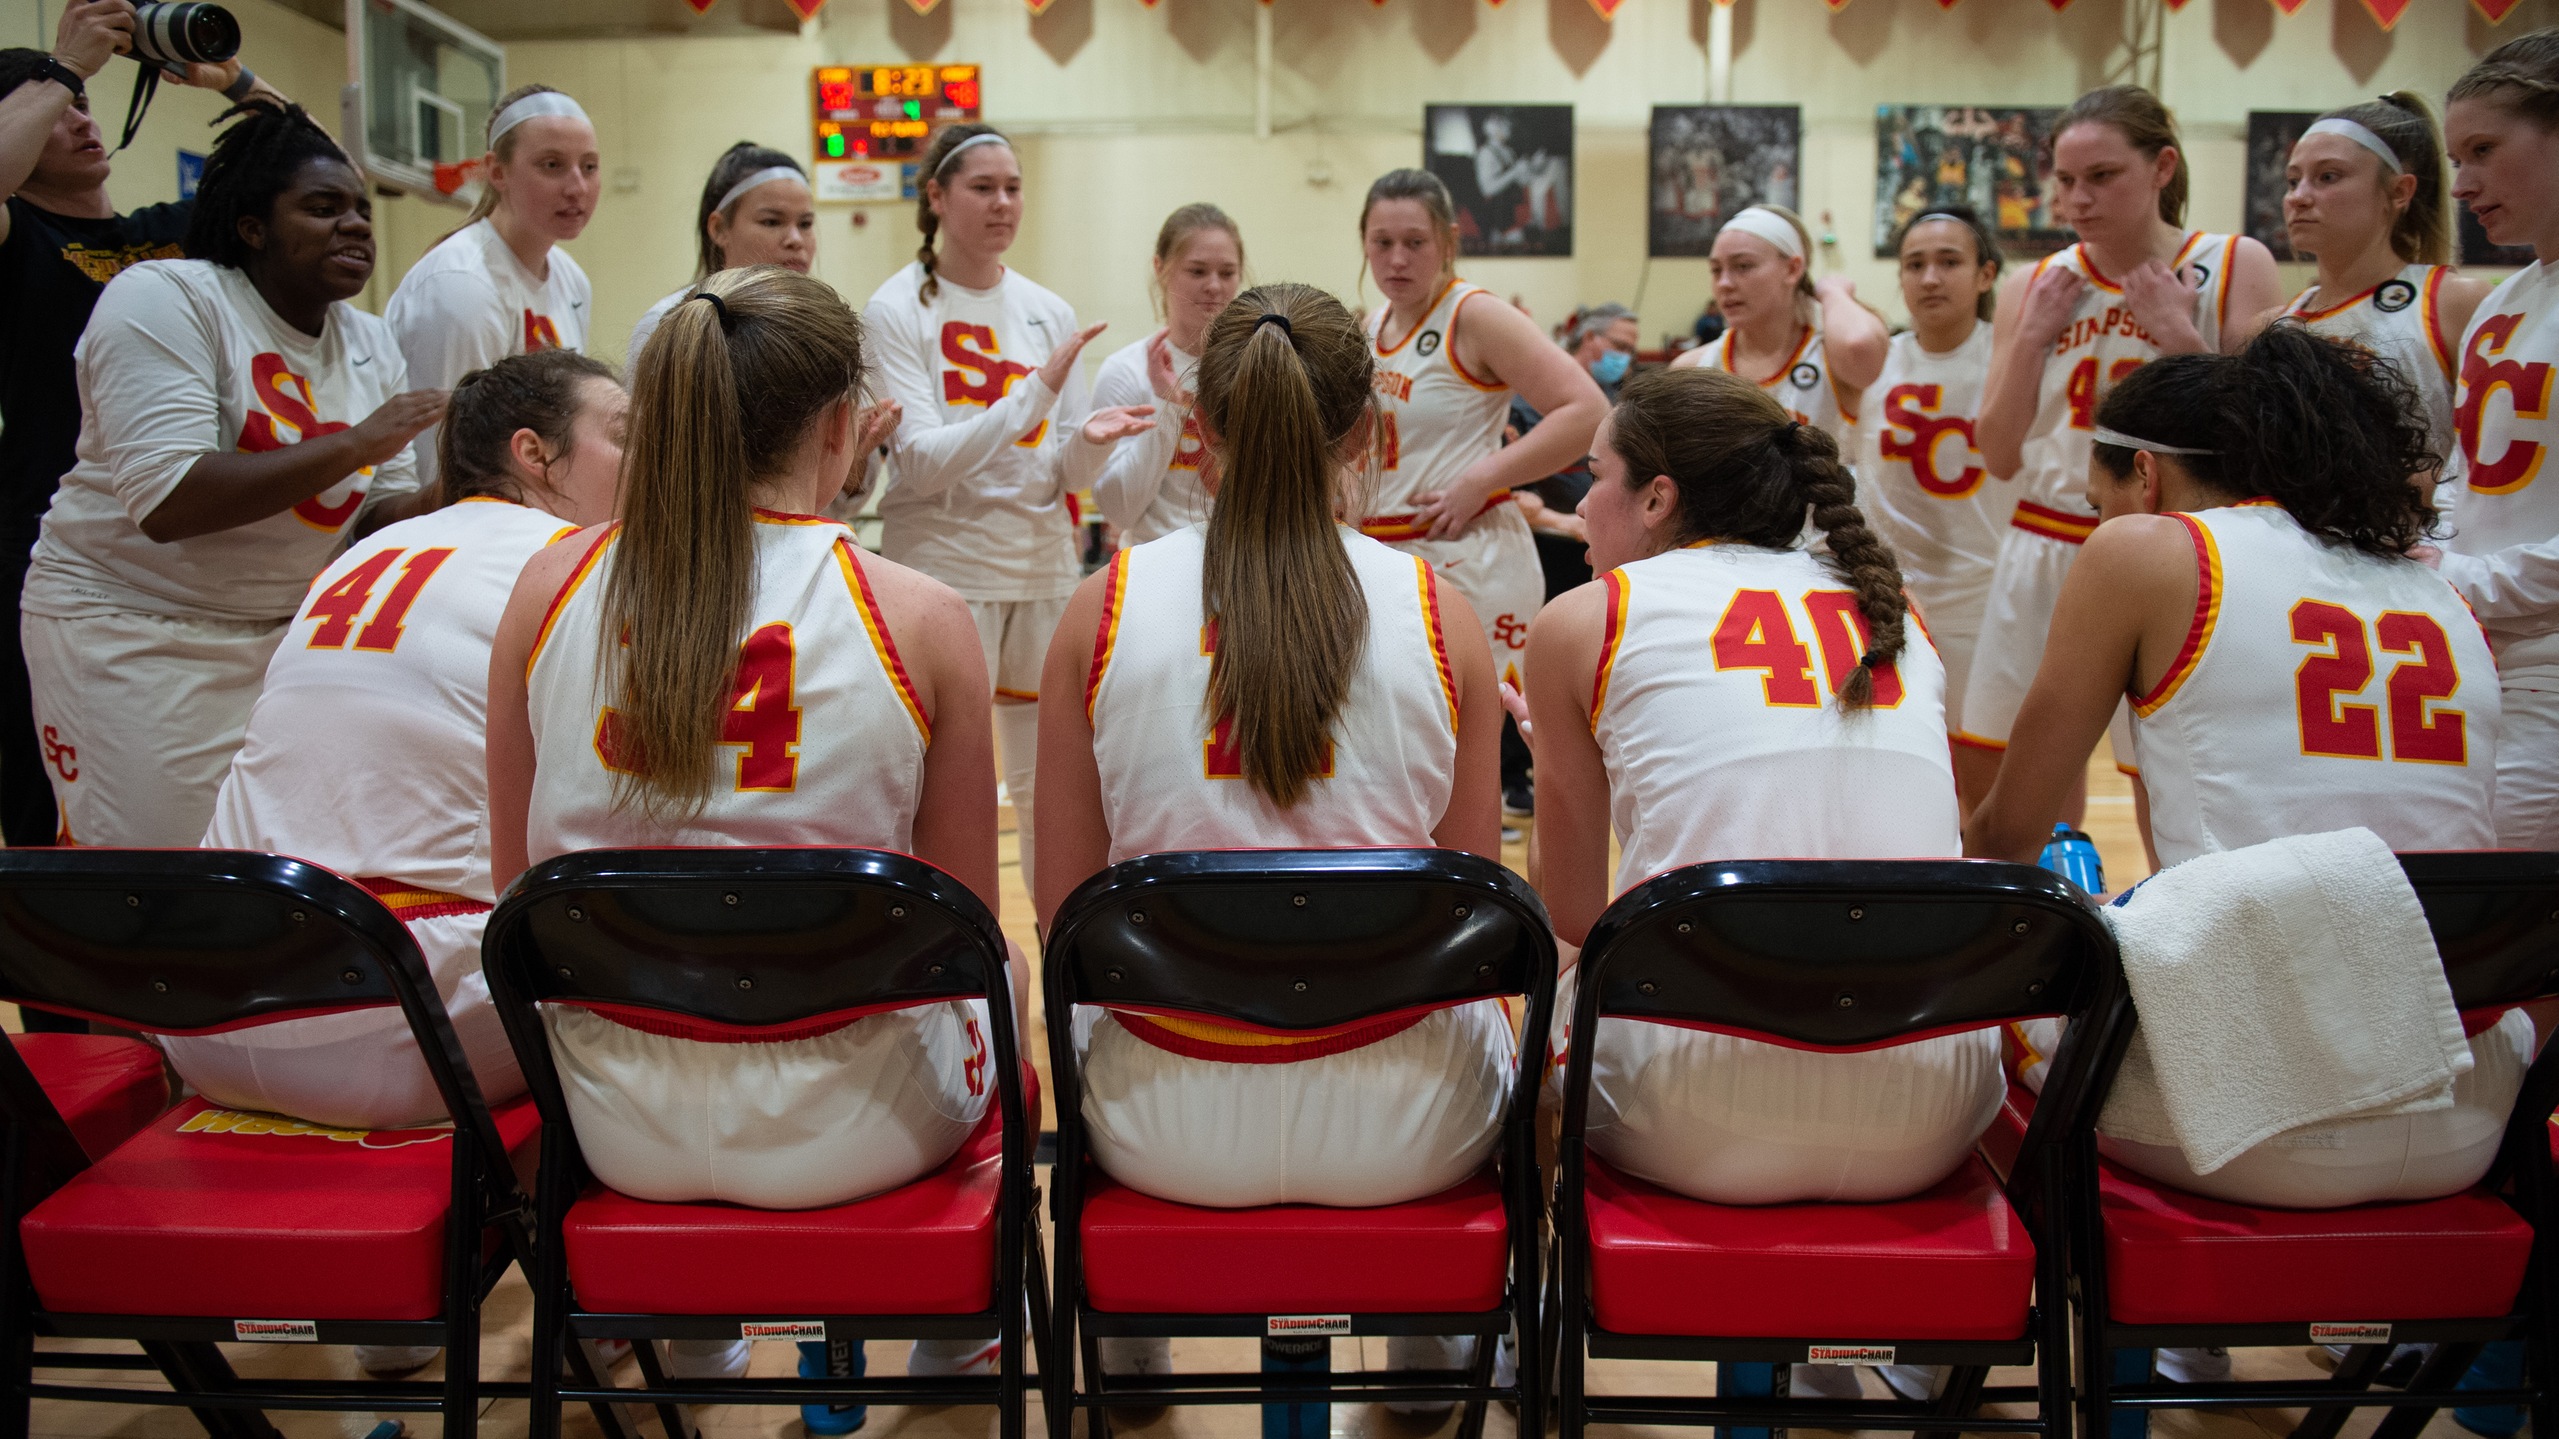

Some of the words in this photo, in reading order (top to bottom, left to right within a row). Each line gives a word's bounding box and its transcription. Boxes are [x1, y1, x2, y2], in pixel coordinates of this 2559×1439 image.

[2056, 307, 2160, 356] SIMPS
[1880, 383, 1987, 500] SC
[2067, 356, 2146, 431] 4
[303, 546, 459, 654] 41
[1494, 613, 1528, 650] SC
[1709, 587, 1906, 710] 40
[592, 620, 803, 793] 4
[2288, 597, 2468, 767] 22
[43, 724, 79, 783] SC
